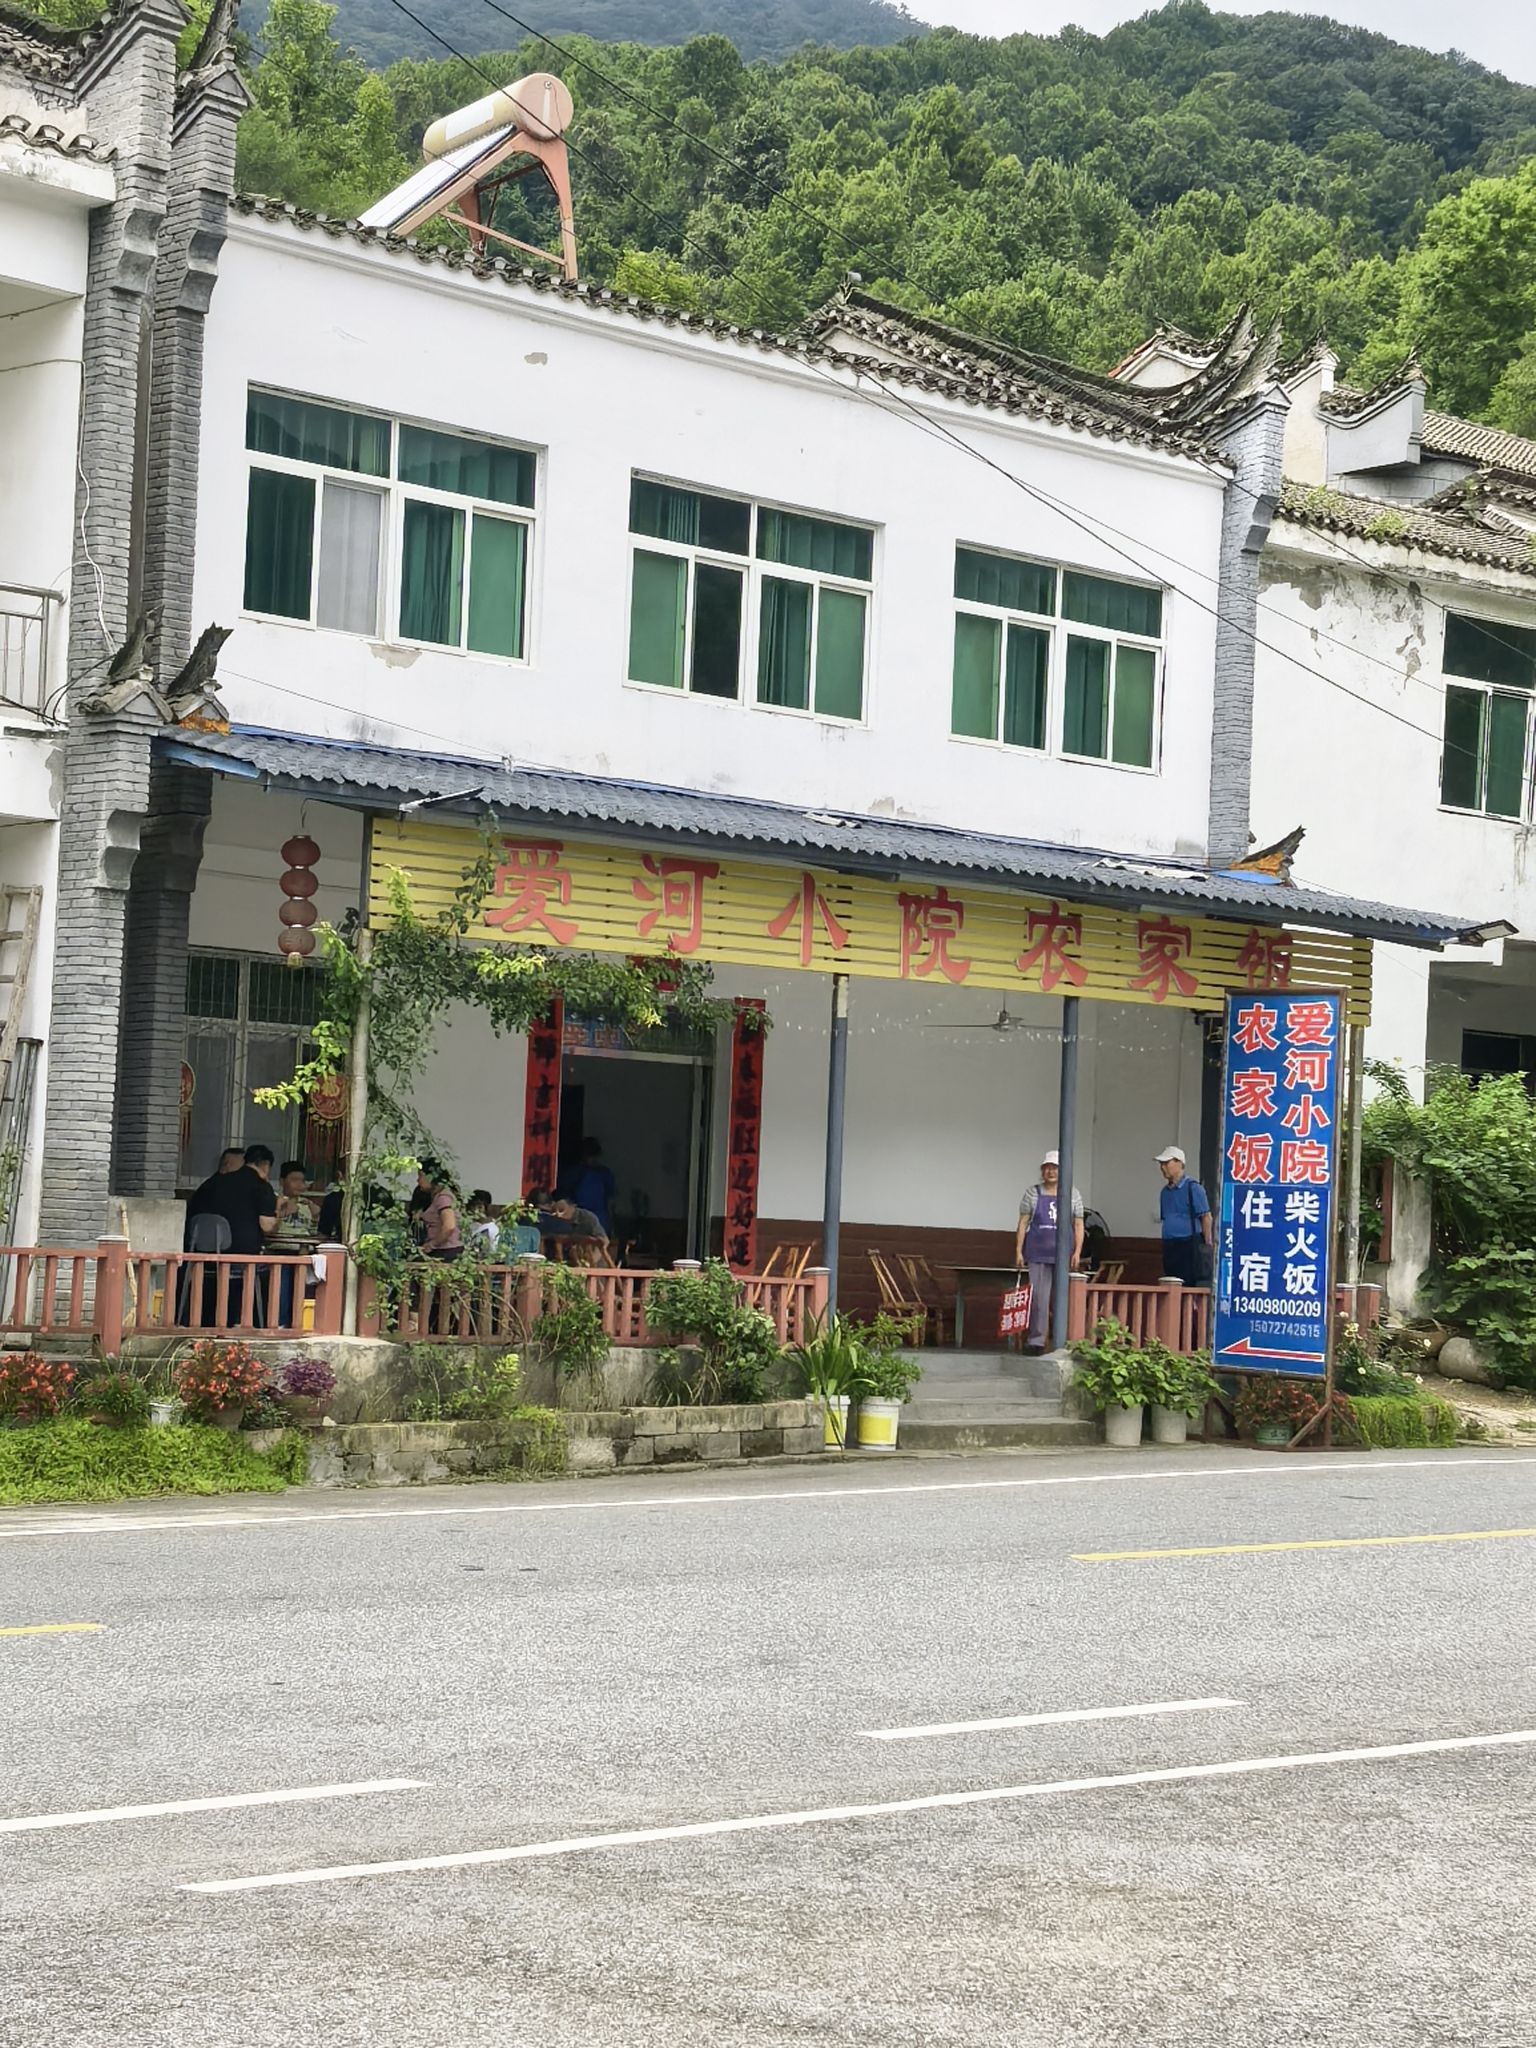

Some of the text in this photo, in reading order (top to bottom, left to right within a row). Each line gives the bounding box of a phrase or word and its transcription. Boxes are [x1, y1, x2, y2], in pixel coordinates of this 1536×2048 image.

[486, 840, 1293, 1002] 爱河小院农家饭
[1227, 1003, 1280, 1184] 农家饭
[1280, 1002, 1334, 1184] 爱河小院
[1239, 1189, 1274, 1293] 住宿
[1283, 1190, 1319, 1296] 柴火饭
[1233, 1296, 1321, 1317] 13409800209
[1249, 1319, 1321, 1338] 15072742615
